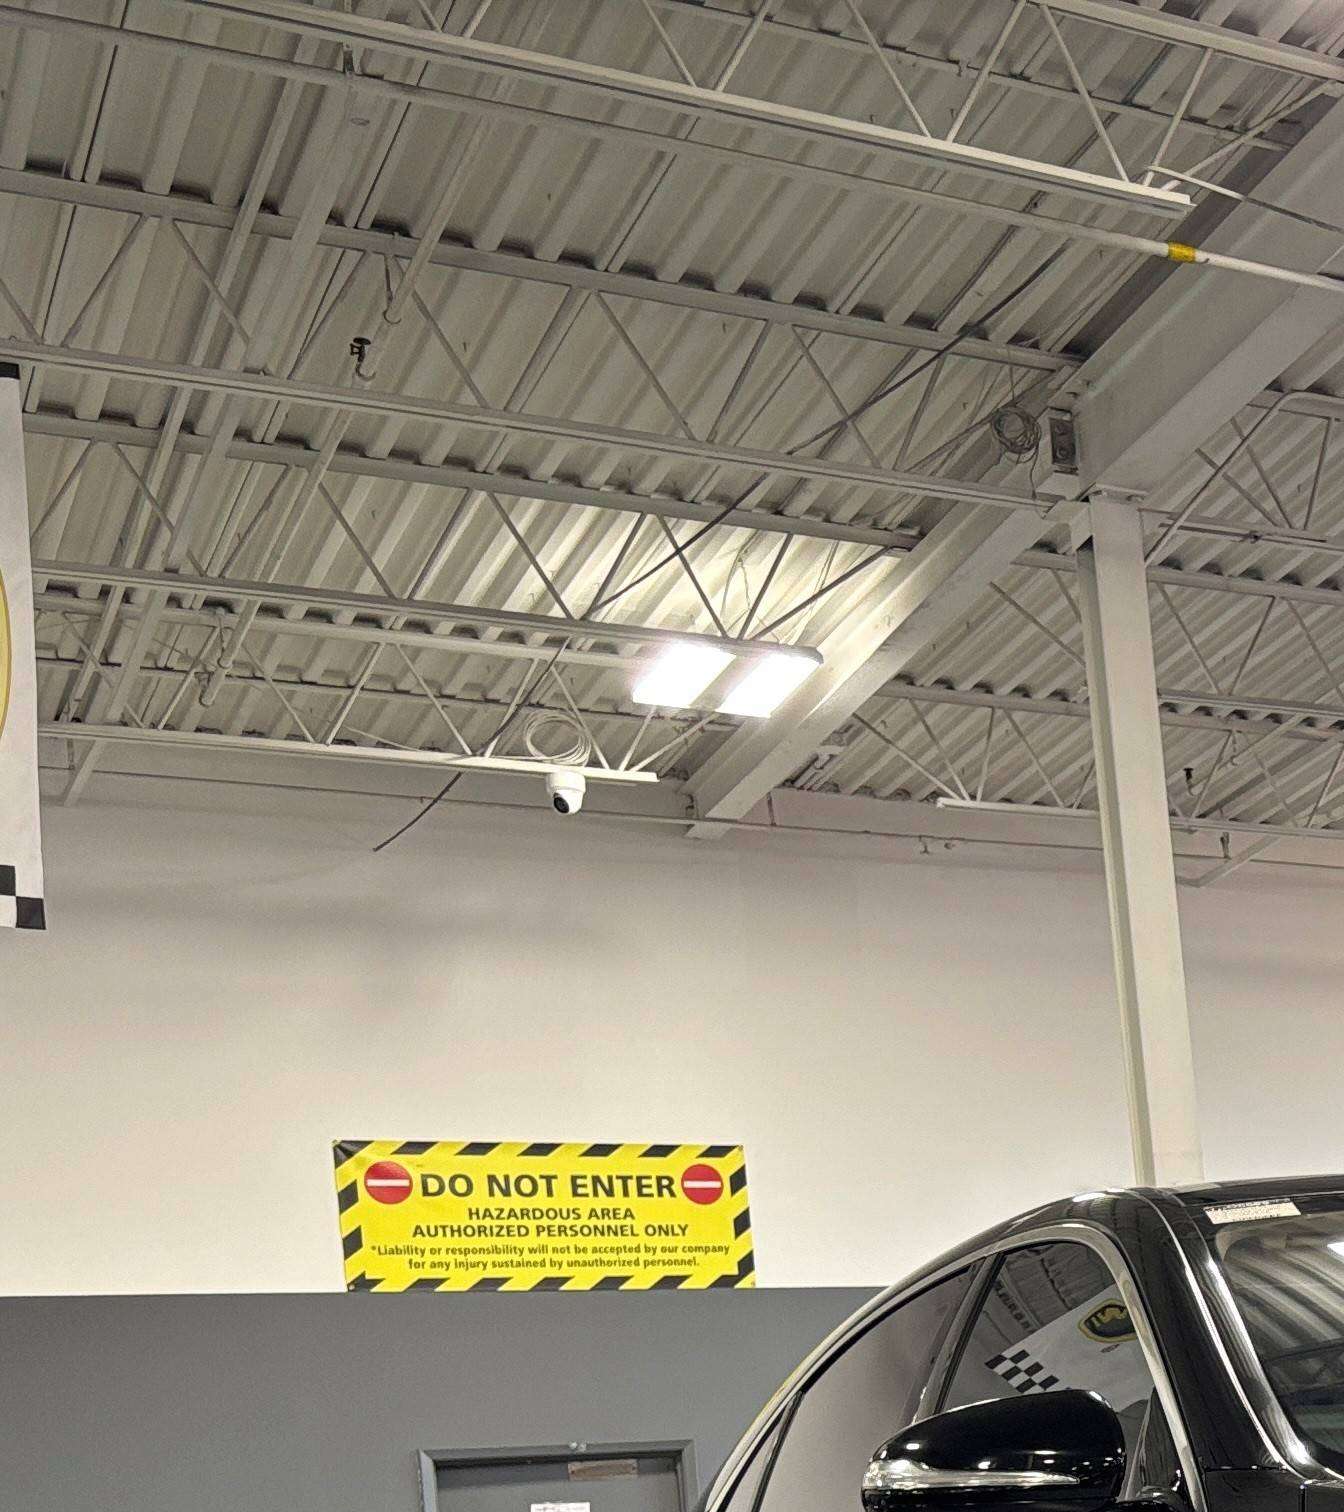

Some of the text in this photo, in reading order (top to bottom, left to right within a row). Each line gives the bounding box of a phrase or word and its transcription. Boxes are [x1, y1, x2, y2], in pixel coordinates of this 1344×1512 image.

[421, 1173, 677, 1198] DO NOT ENTER
[468, 1207, 636, 1221] HAZARDOUS AREA
[412, 1224, 689, 1238] AUTHORIZED PERSONNEL ONLY
[430, 1247, 442, 1255] or
[445, 1244, 524, 1257] responsibility
[528, 1244, 549, 1255] will
[552, 1245, 570, 1255] not
[574, 1244, 588, 1255] be
[591, 1244, 641, 1256] accepted
[644, 1244, 657, 1256] by
[660, 1246, 679, 1254] our
[681, 1245, 730, 1256] company
[408, 1259, 425, 1270] for
[429, 1261, 451, 1271] any
[491, 1258, 546, 1269] sustained
[549, 1258, 563, 1270] by
[566, 1257, 640, 1268] unauthorized
[643, 1256, 700, 1269] personnel.
